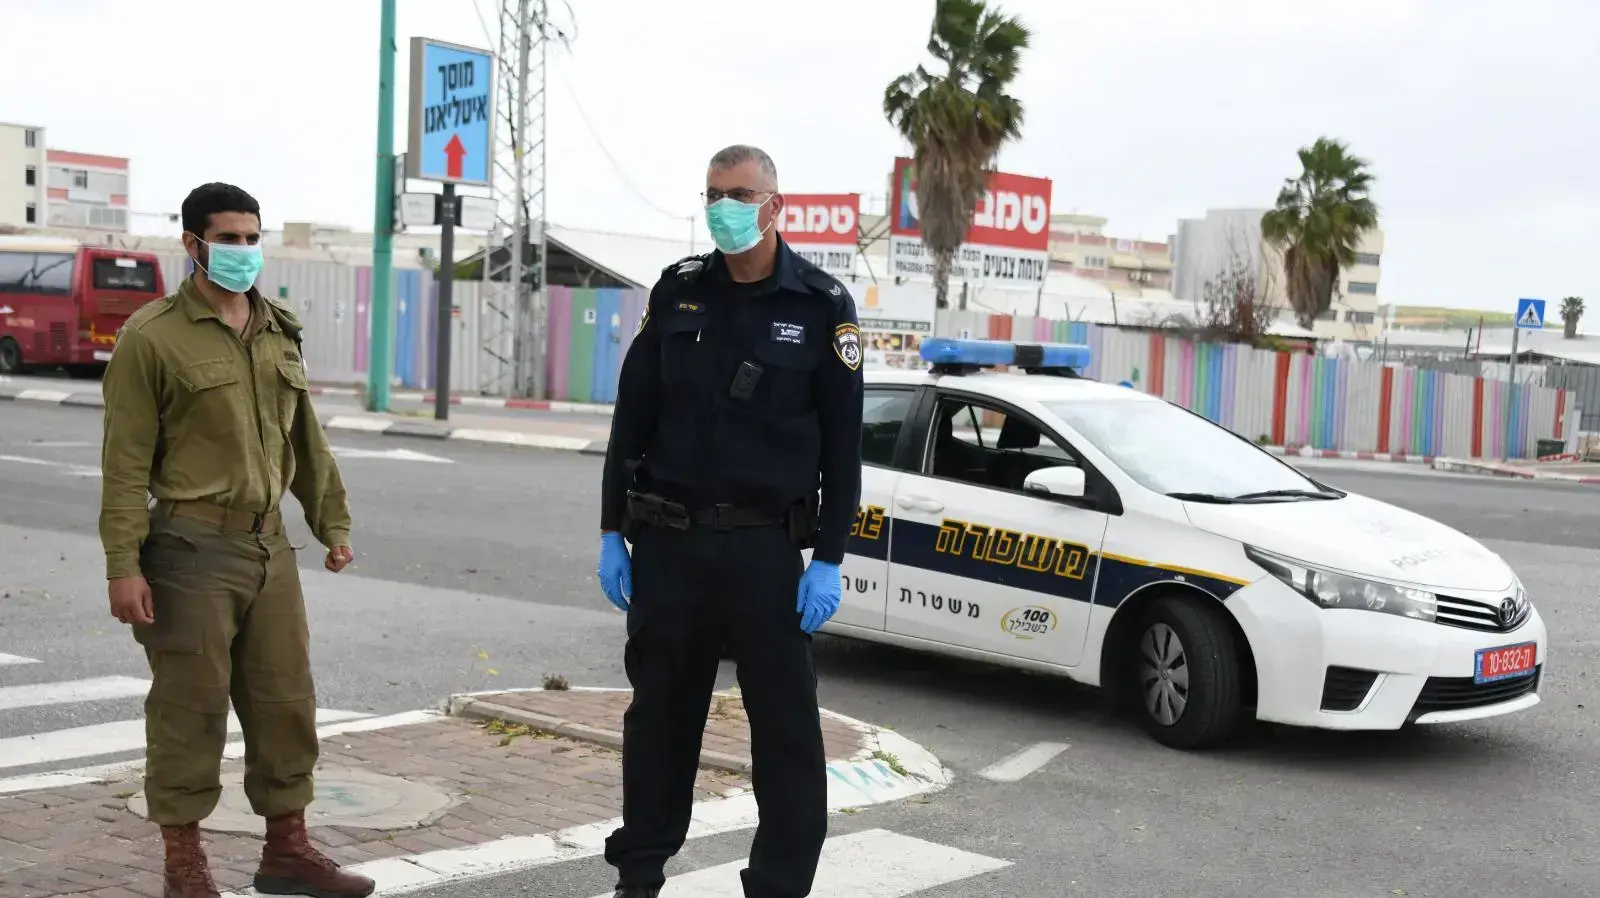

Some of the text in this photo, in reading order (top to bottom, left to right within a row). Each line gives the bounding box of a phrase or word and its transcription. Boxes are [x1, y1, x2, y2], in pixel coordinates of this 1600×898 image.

[438, 60, 475, 101] מוסך
[424, 94, 489, 135] איטליאנו
[777, 205, 856, 235] טמבו
[974, 189, 1048, 235] טמב
[983, 254, 1016, 280] צבעים
[1017, 257, 1044, 281] צומת
[935, 517, 1091, 580] משטרה
[842, 575, 981, 619] משטרת ישר
[1009, 618, 1048, 634] בשבילך
[1023, 609, 1050, 623] 100
